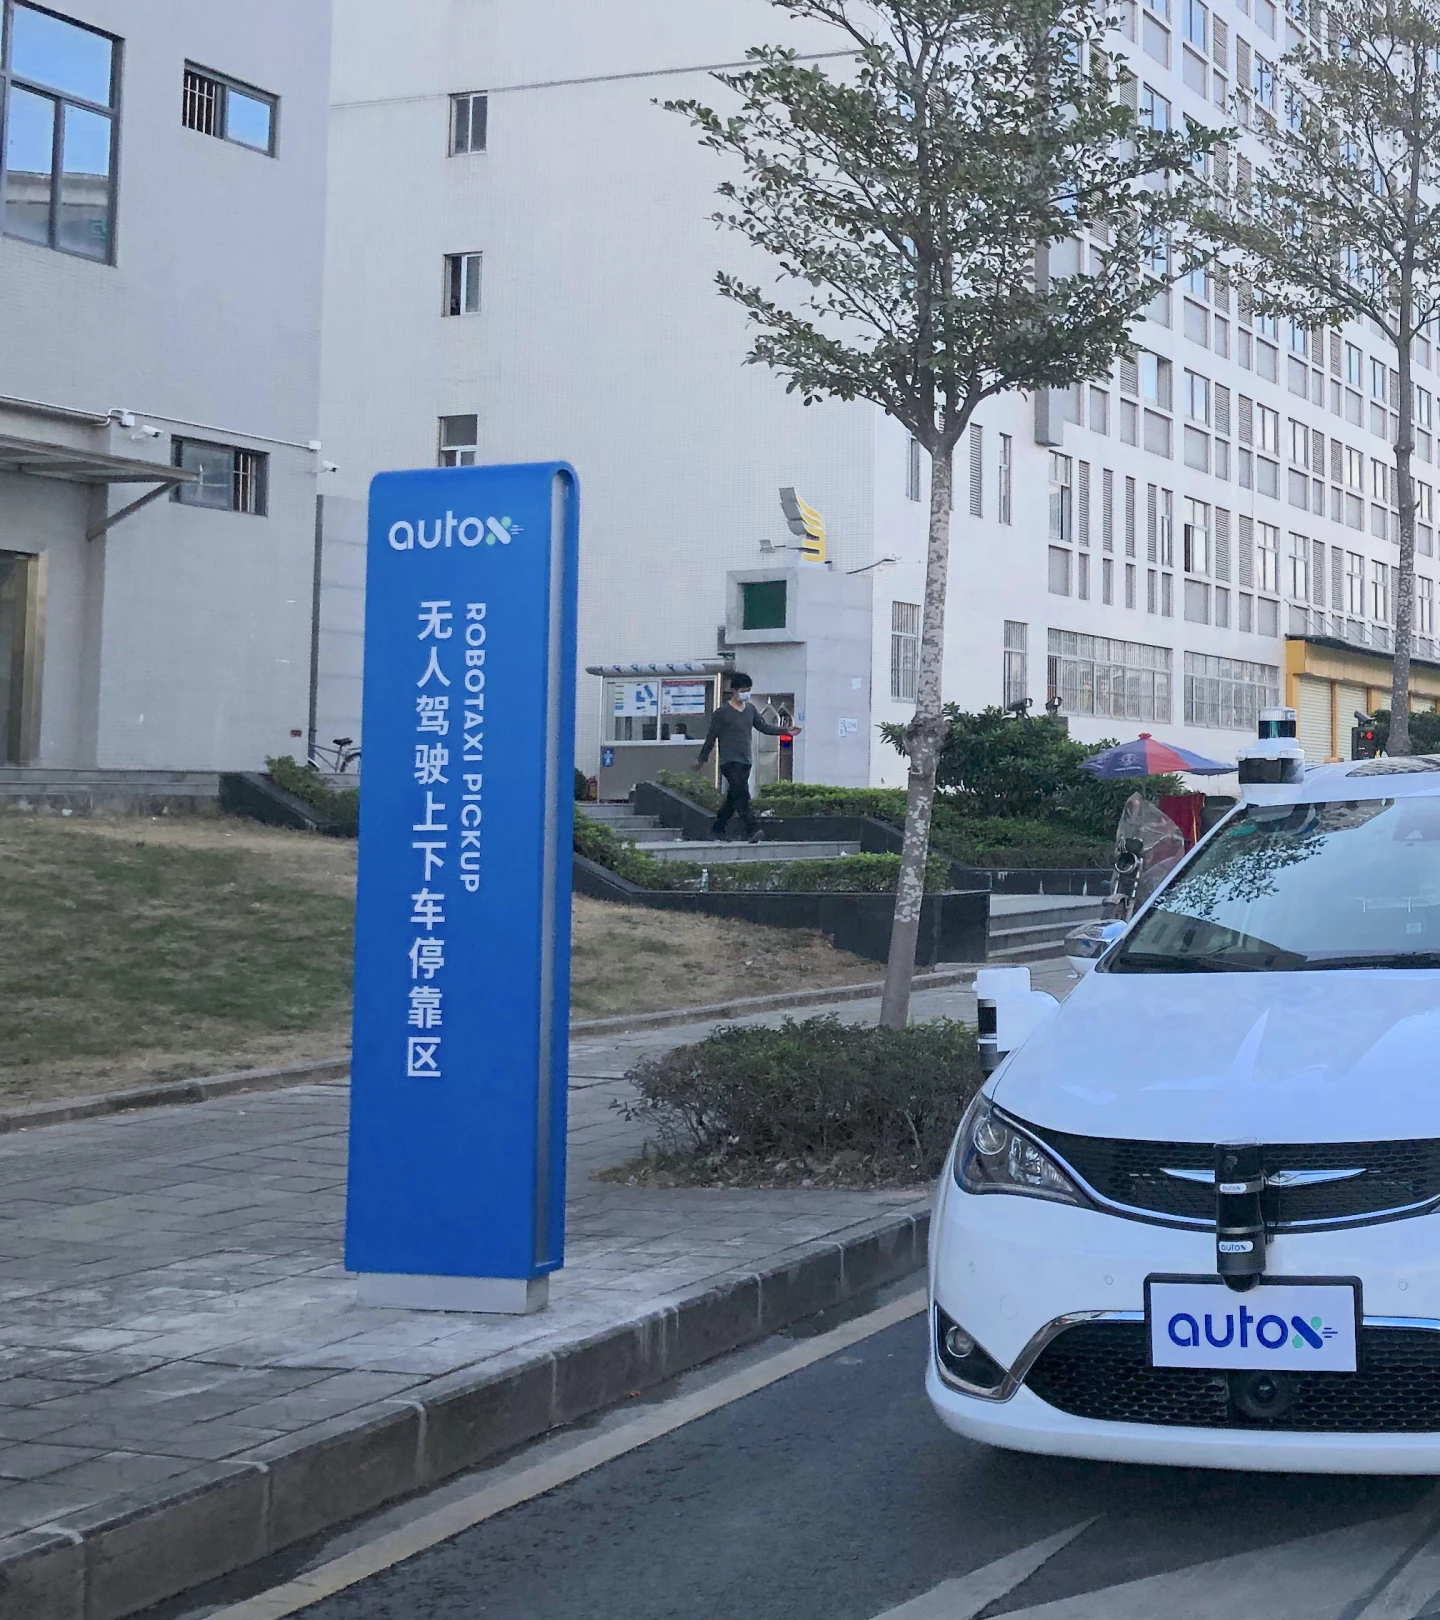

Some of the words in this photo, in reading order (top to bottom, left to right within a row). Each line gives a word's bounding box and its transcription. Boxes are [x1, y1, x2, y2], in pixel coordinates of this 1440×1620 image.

[462, 602, 487, 761] ROBOTAXI
[407, 600, 454, 1078] 无人驾驶上下车停靠区
[460, 773, 483, 893] PICKUP
[1168, 1305, 1326, 1350] autox
